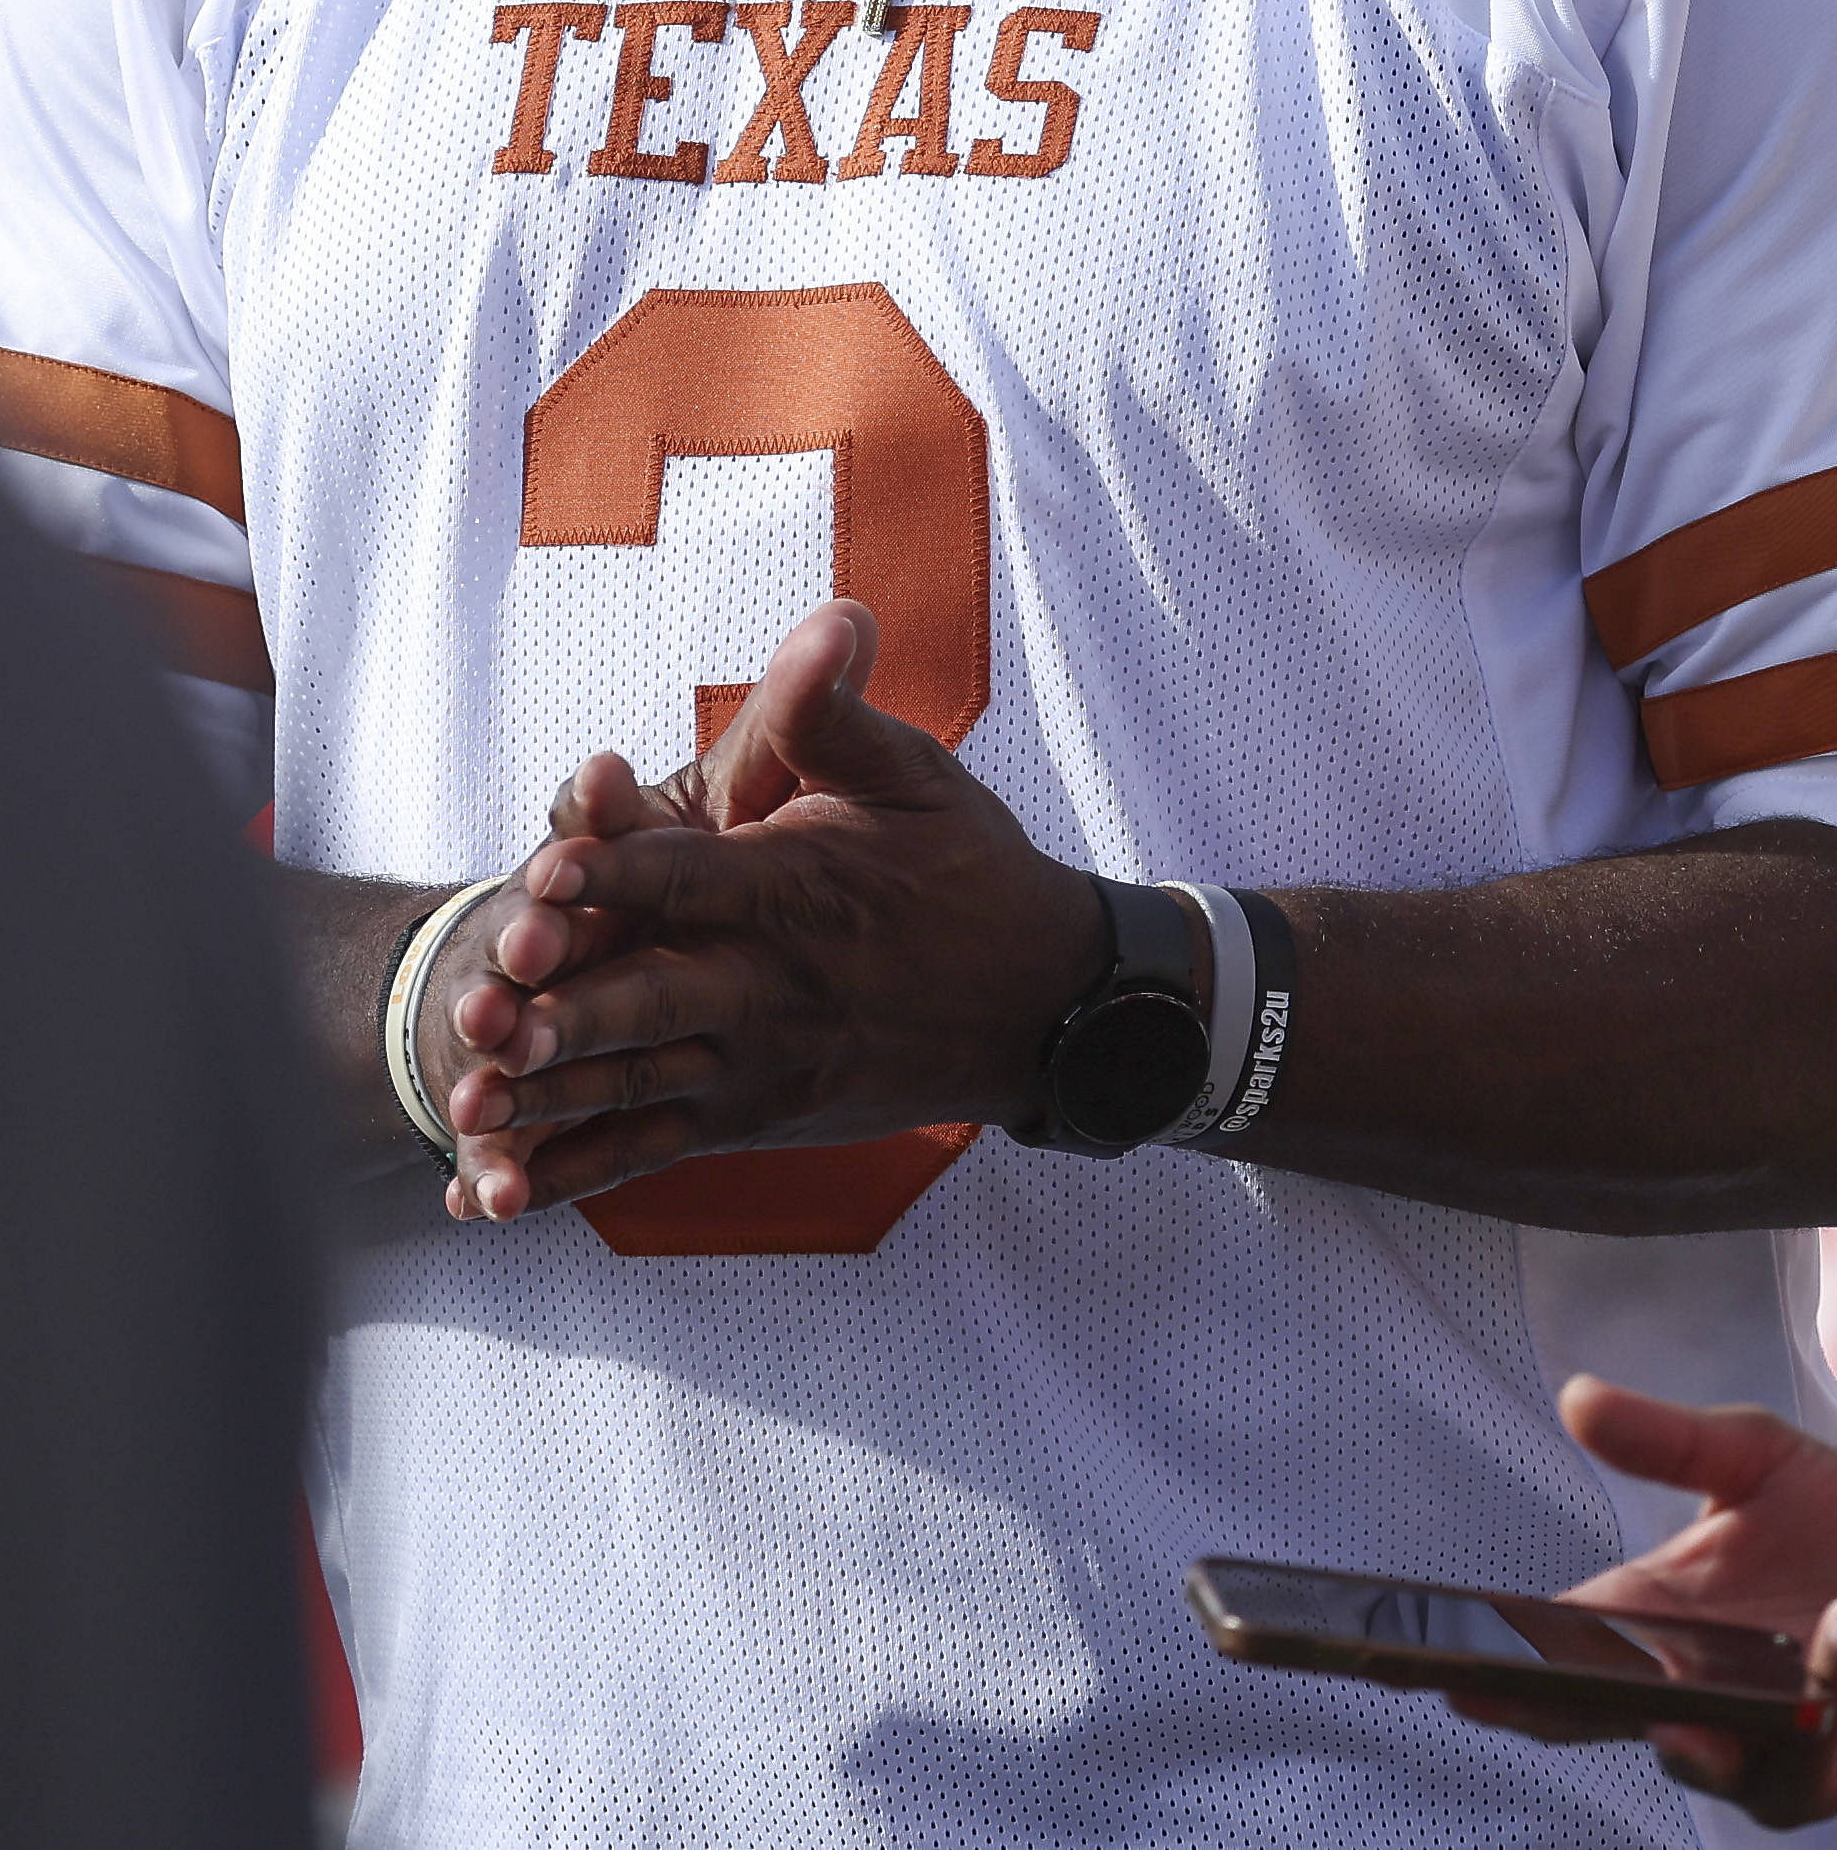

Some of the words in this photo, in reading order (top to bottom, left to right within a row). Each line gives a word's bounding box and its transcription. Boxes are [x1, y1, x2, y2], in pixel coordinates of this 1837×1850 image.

[489, 0, 1102, 185] TEXAS
[519, 281, 991, 1257] 3
[1219, 990, 1290, 1132] @sparks2u
